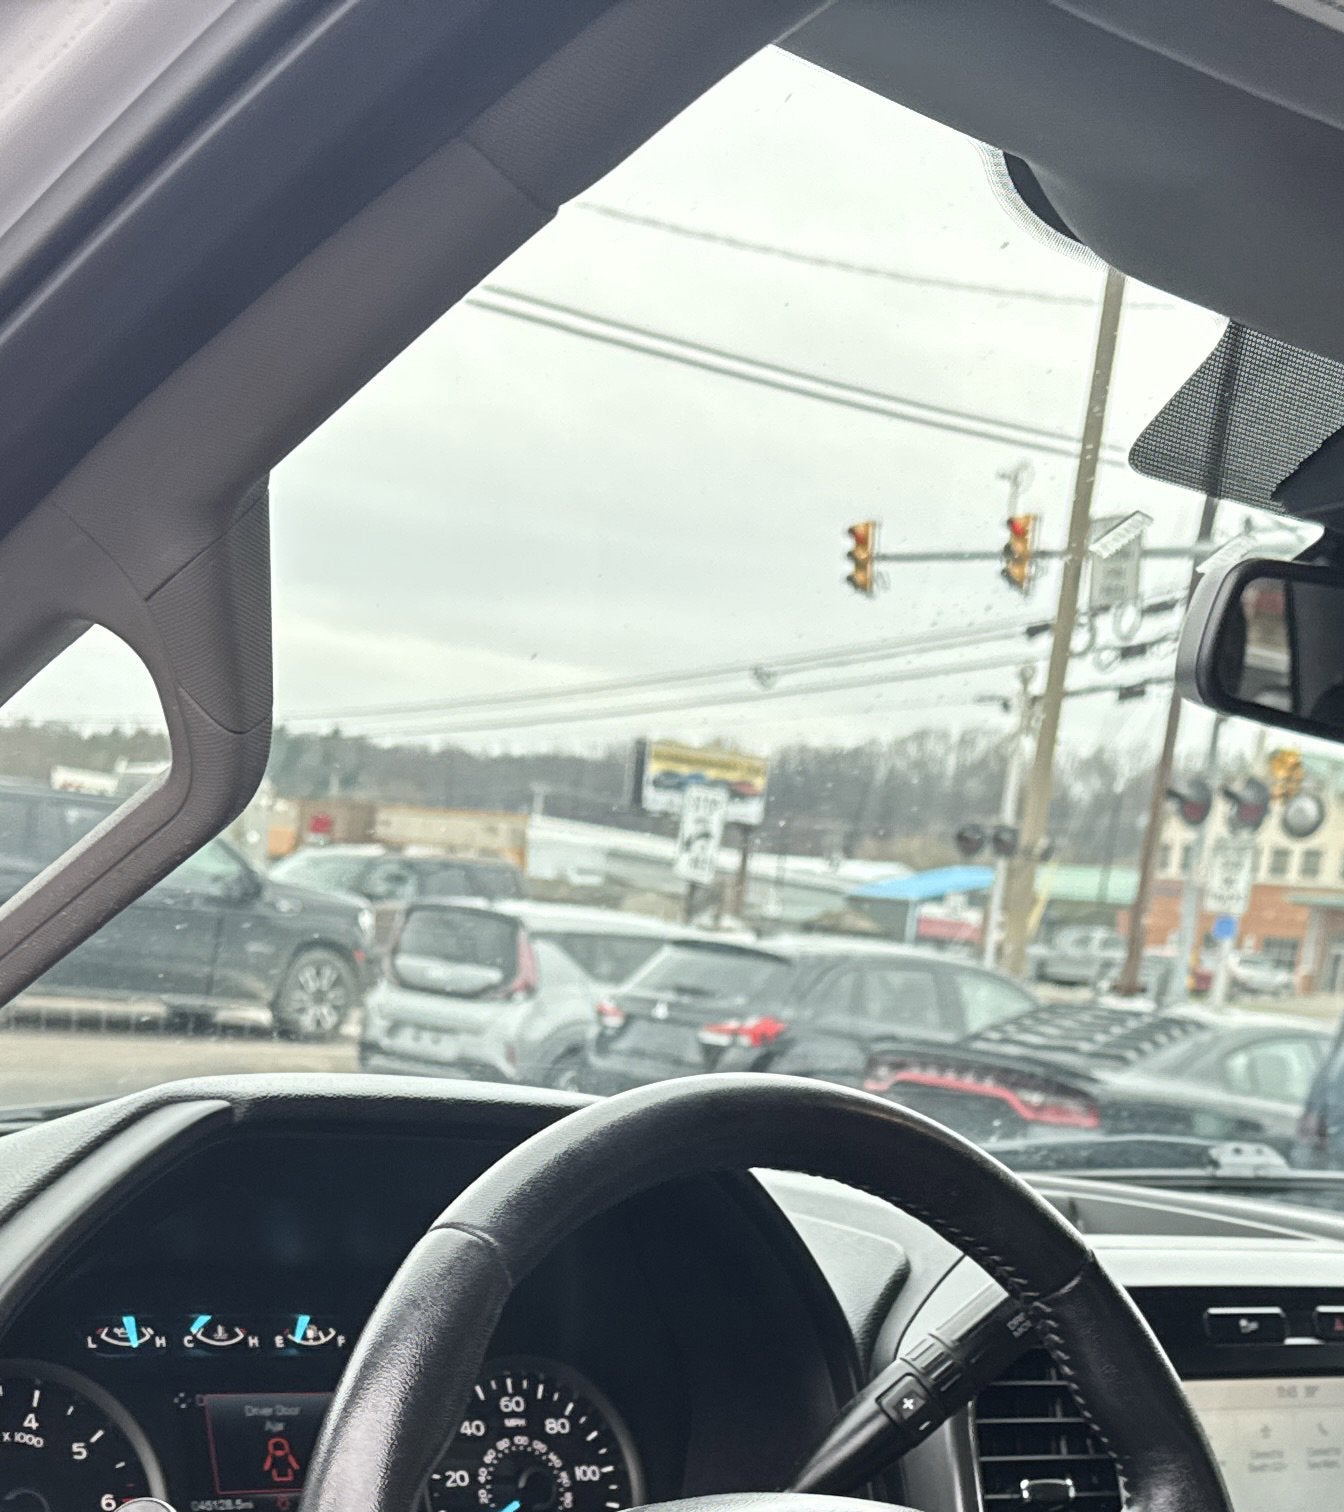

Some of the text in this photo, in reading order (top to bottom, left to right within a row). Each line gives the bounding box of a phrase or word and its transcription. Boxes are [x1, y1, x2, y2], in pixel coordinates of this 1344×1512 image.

[87, 1336, 97, 1348] L
[156, 1336, 166, 1348] H
[183, 1336, 195, 1348] C
[248, 1336, 259, 1348] H
[275, 1336, 285, 1348] E
[336, 1336, 346, 1348] F
[499, 1396, 525, 1412] 60
[23, 1413, 39, 1430] 4
[460, 1420, 485, 1436] 40
[544, 1418, 570, 1434] 80
[14, 1432, 44, 1448] 1000
[71, 1442, 88, 1460] 5
[445, 1470, 469, 1487] 20
[574, 1465, 600, 1481] 100
[101, 1493, 116, 1511] 6
